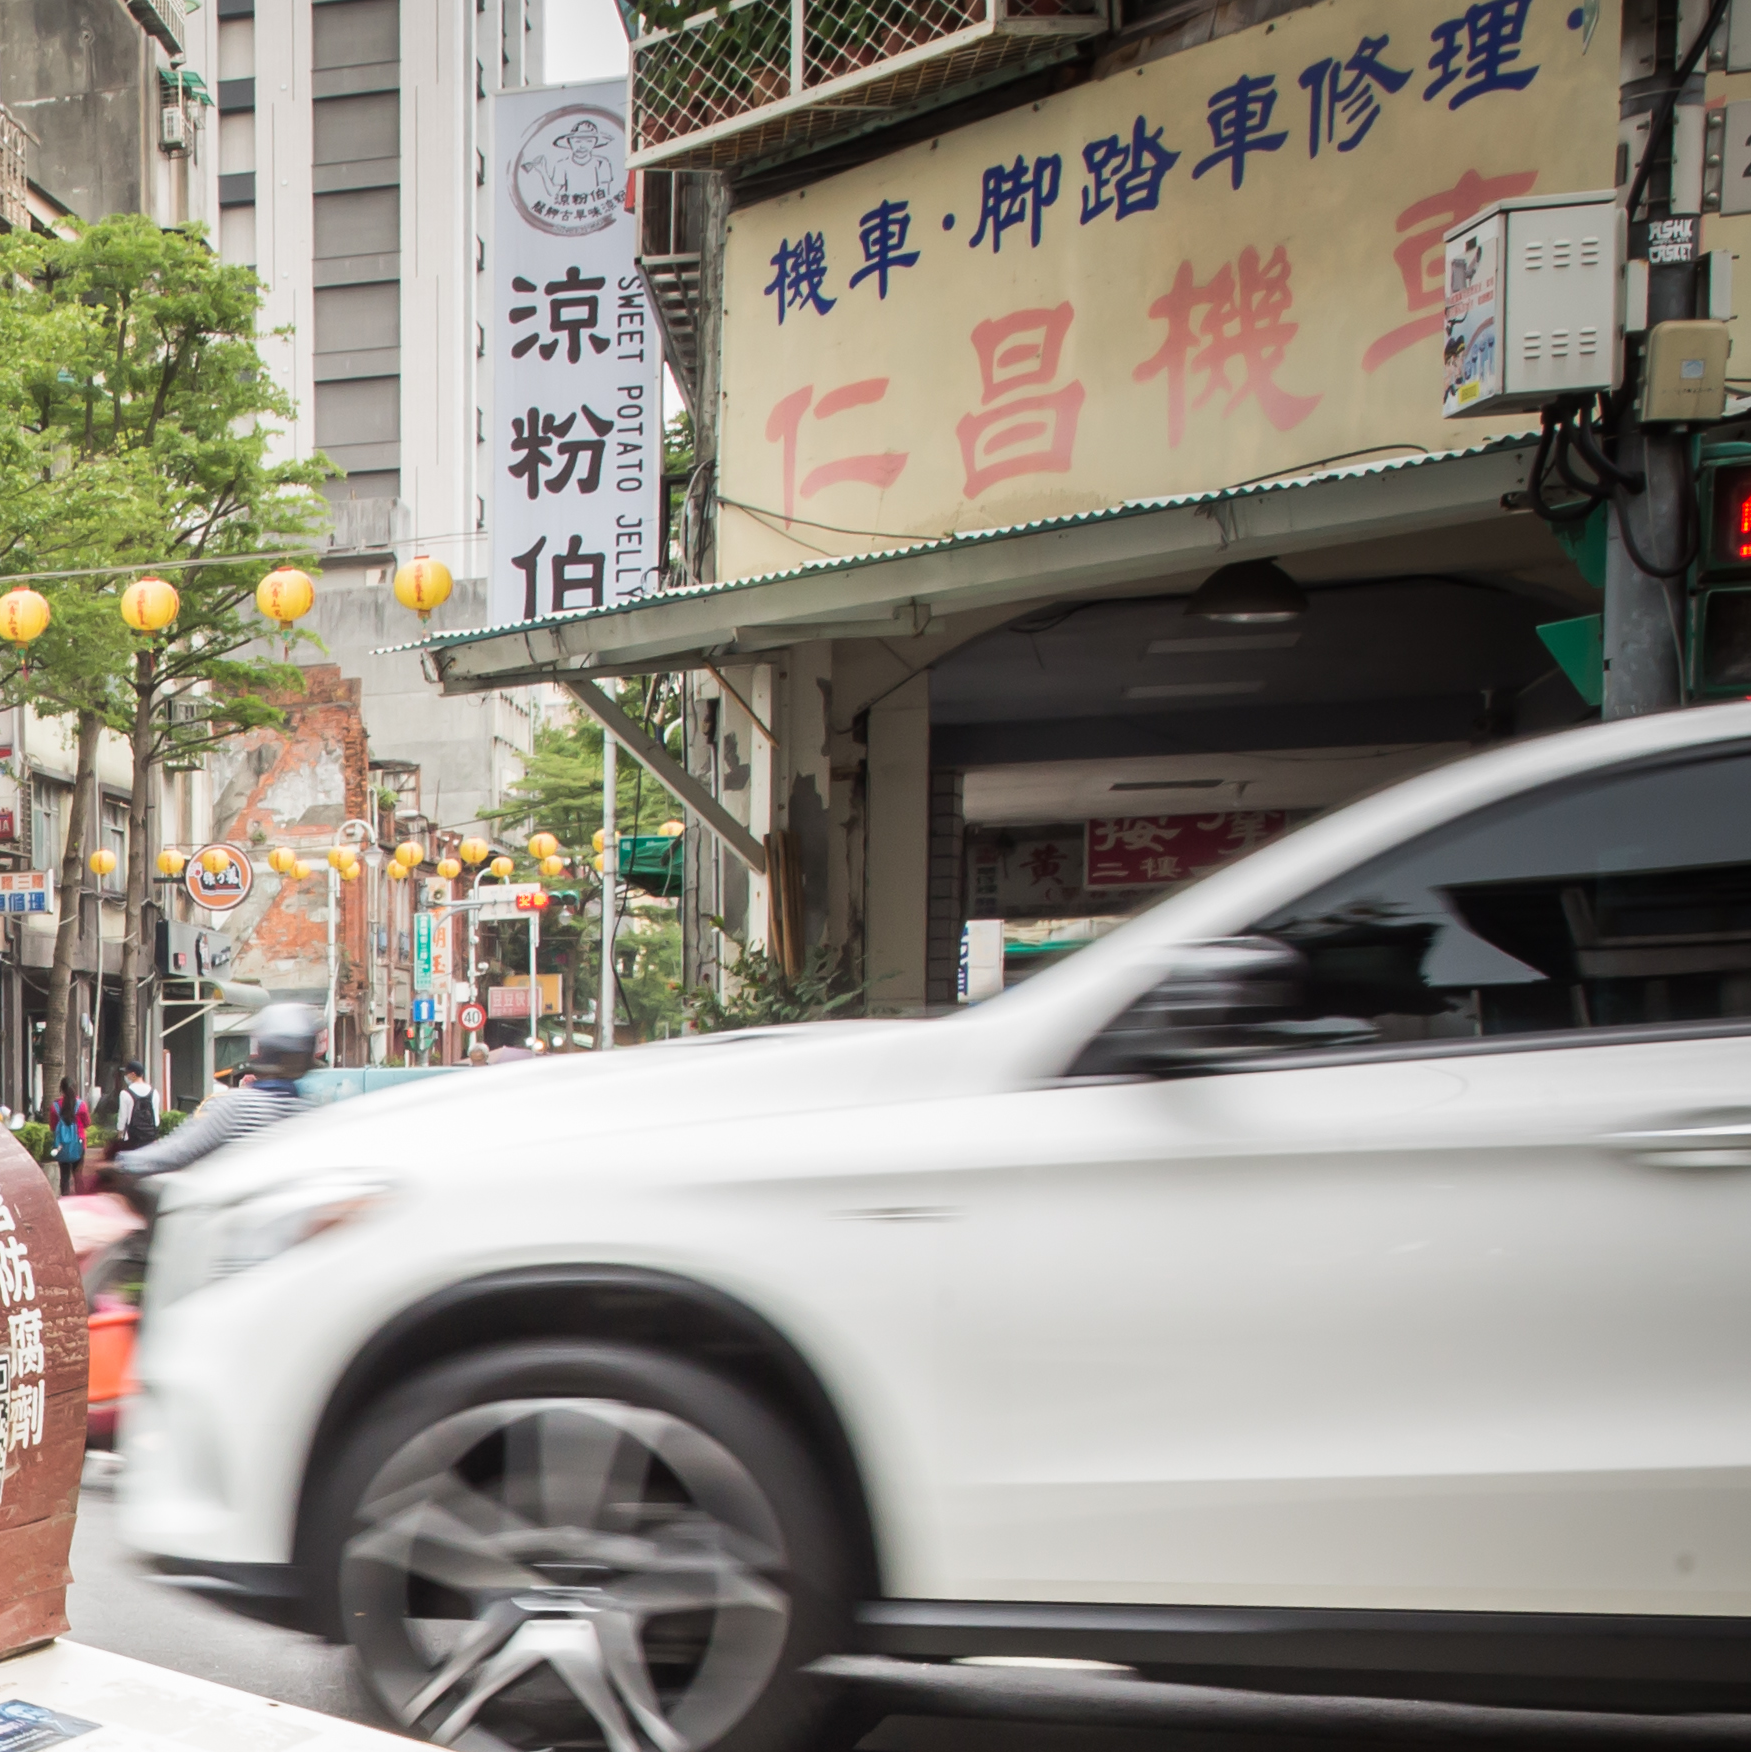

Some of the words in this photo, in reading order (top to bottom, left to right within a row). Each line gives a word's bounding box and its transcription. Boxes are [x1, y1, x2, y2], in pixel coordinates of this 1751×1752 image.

[616, 275, 645, 363] SWEET
[508, 266, 615, 621] 涼粉伯
[616, 385, 644, 492] POTATO
[615, 514, 644, 598] JELLY
[464, 1010, 481, 1025] 40
